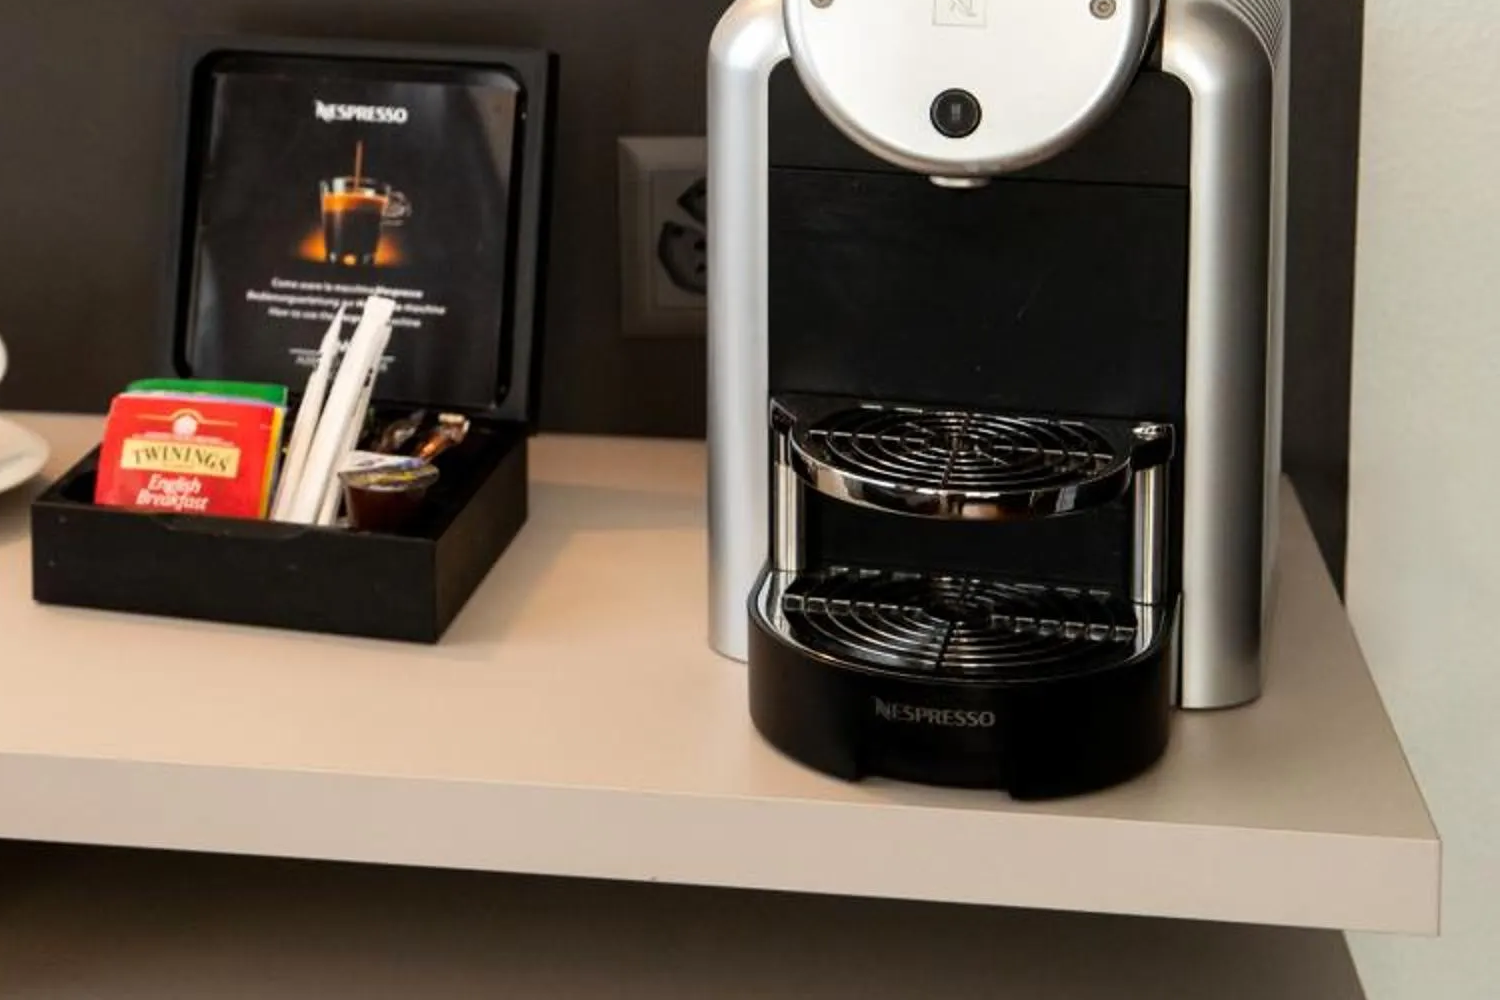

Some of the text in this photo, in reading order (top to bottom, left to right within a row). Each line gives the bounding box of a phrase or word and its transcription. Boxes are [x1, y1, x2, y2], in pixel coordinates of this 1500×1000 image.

[314, 100, 409, 124] NESPRESSO
[133, 446, 229, 471] TWININGS
[148, 473, 202, 495] English
[136, 489, 209, 511] Breakfast
[874, 696, 995, 727] NESPRESSO
